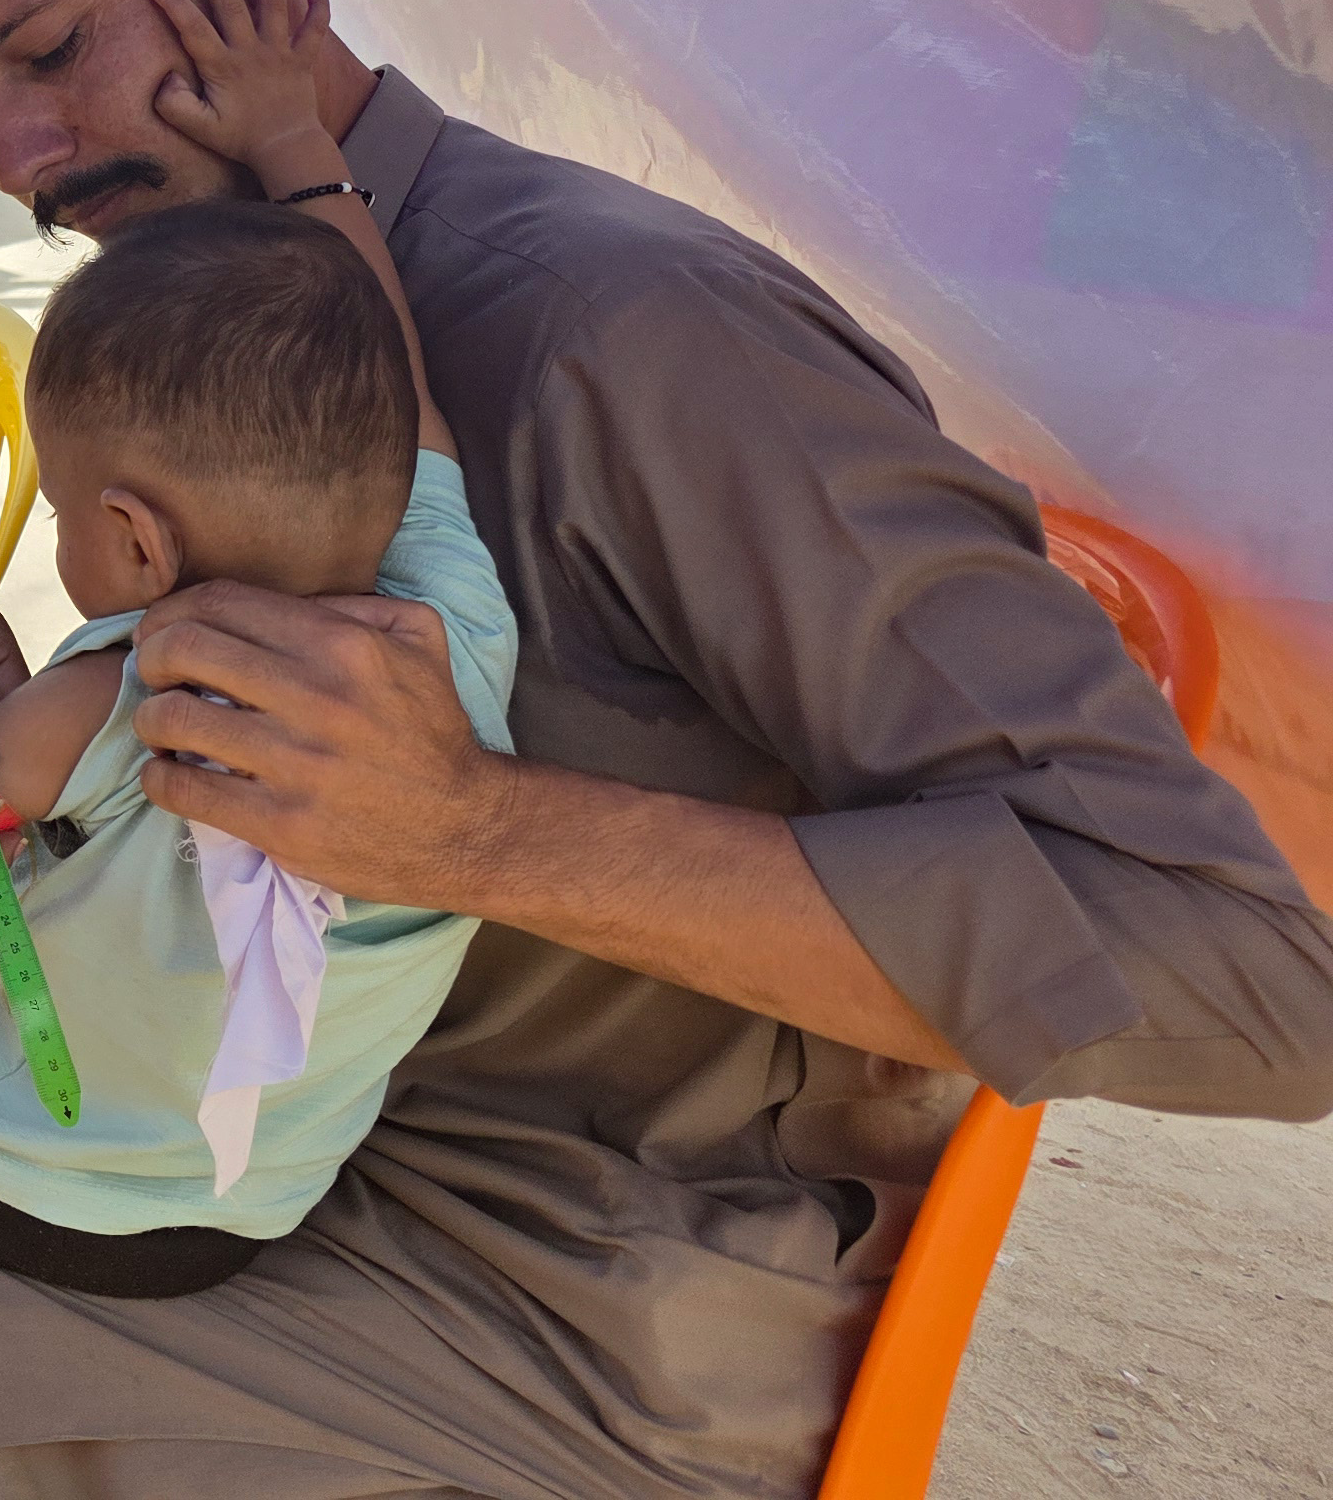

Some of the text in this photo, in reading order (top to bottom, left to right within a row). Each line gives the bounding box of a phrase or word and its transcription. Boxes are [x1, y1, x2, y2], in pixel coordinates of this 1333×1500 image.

[0, 914, 12, 927] 24
[9, 941, 21, 954] 25
[19, 969, 31, 983] 26
[29, 999, 40, 1011] 27
[38, 1029, 50, 1042] 28
[47, 1058, 60, 1072] 29
[57, 1088, 69, 1102] 30
